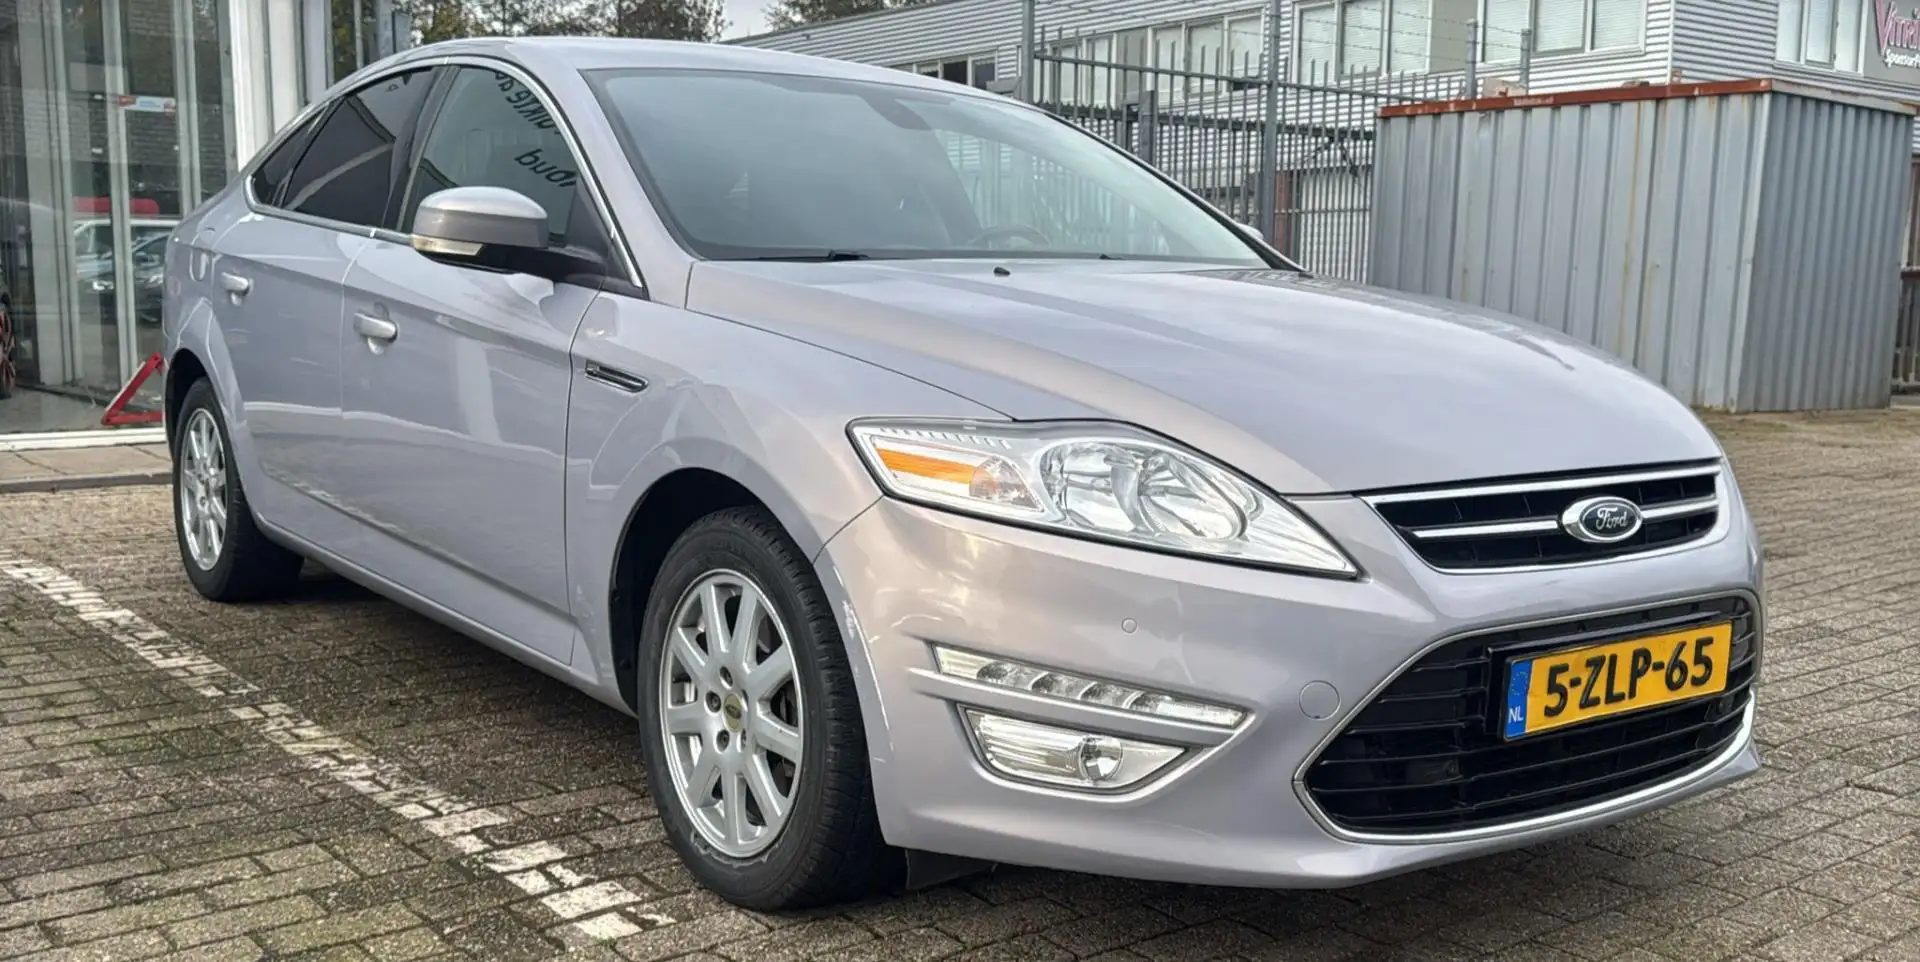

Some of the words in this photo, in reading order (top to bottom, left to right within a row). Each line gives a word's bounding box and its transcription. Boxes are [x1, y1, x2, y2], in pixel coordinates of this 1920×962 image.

[1596, 507, 1628, 531] Ford
[1543, 636, 1714, 717] 5-ZLP-65
[1508, 706, 1524, 724] NL
